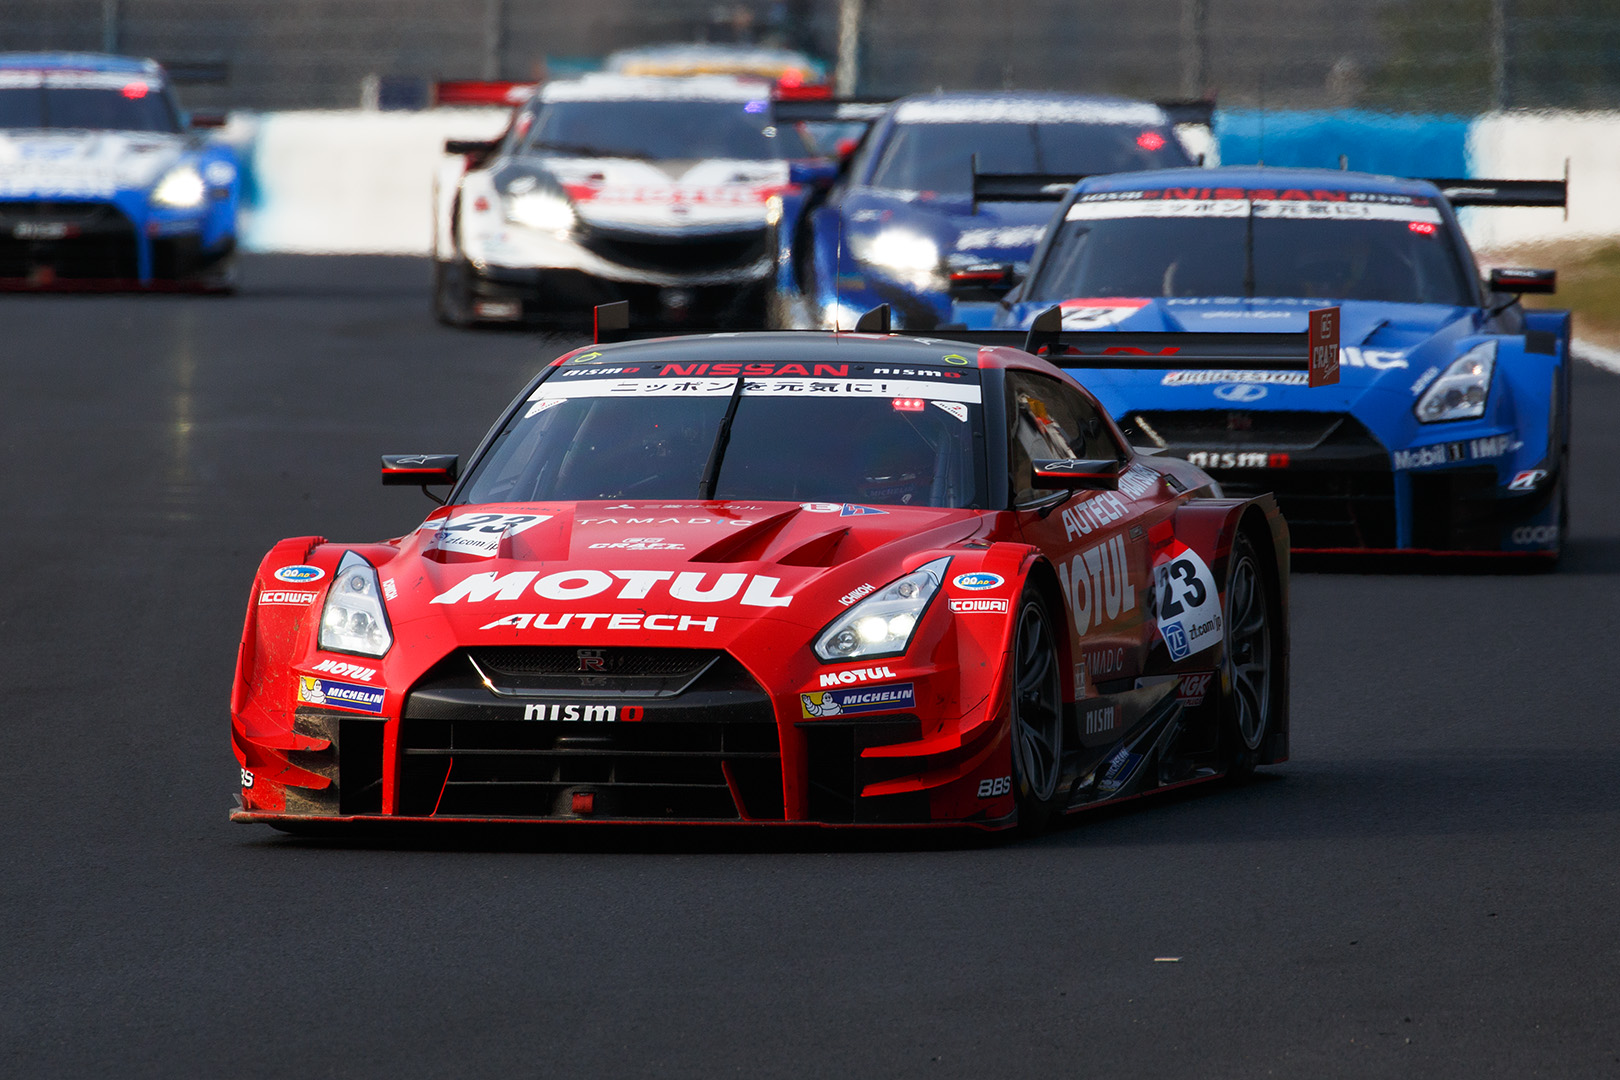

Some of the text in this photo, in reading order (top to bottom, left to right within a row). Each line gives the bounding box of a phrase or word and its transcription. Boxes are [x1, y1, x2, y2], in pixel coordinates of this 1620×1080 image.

[1163, 187, 1347, 202] NISSAN
[562, 367, 641, 377] nismo
[658, 363, 849, 377] NISSAN
[873, 367, 961, 379] nismo
[1187, 451, 1290, 469] nismo
[1394, 444, 1447, 470] Mobil
[440, 514, 537, 533] 23
[577, 517, 752, 526] TAMADIC
[1061, 491, 1130, 542] AUTECH
[429, 569, 794, 608] MOTUL
[838, 583, 876, 606] ICHIKOH
[1160, 558, 1207, 621] 23
[479, 613, 719, 632] AUTECH
[312, 659, 377, 682] MOTUL
[819, 666, 897, 688] MOTUL
[327, 687, 384, 704] MICHELIN
[843, 689, 913, 705] MICHELIN
[523, 703, 645, 722] nismo
[1086, 704, 1122, 734] nismo
[977, 775, 1011, 797] BBS
